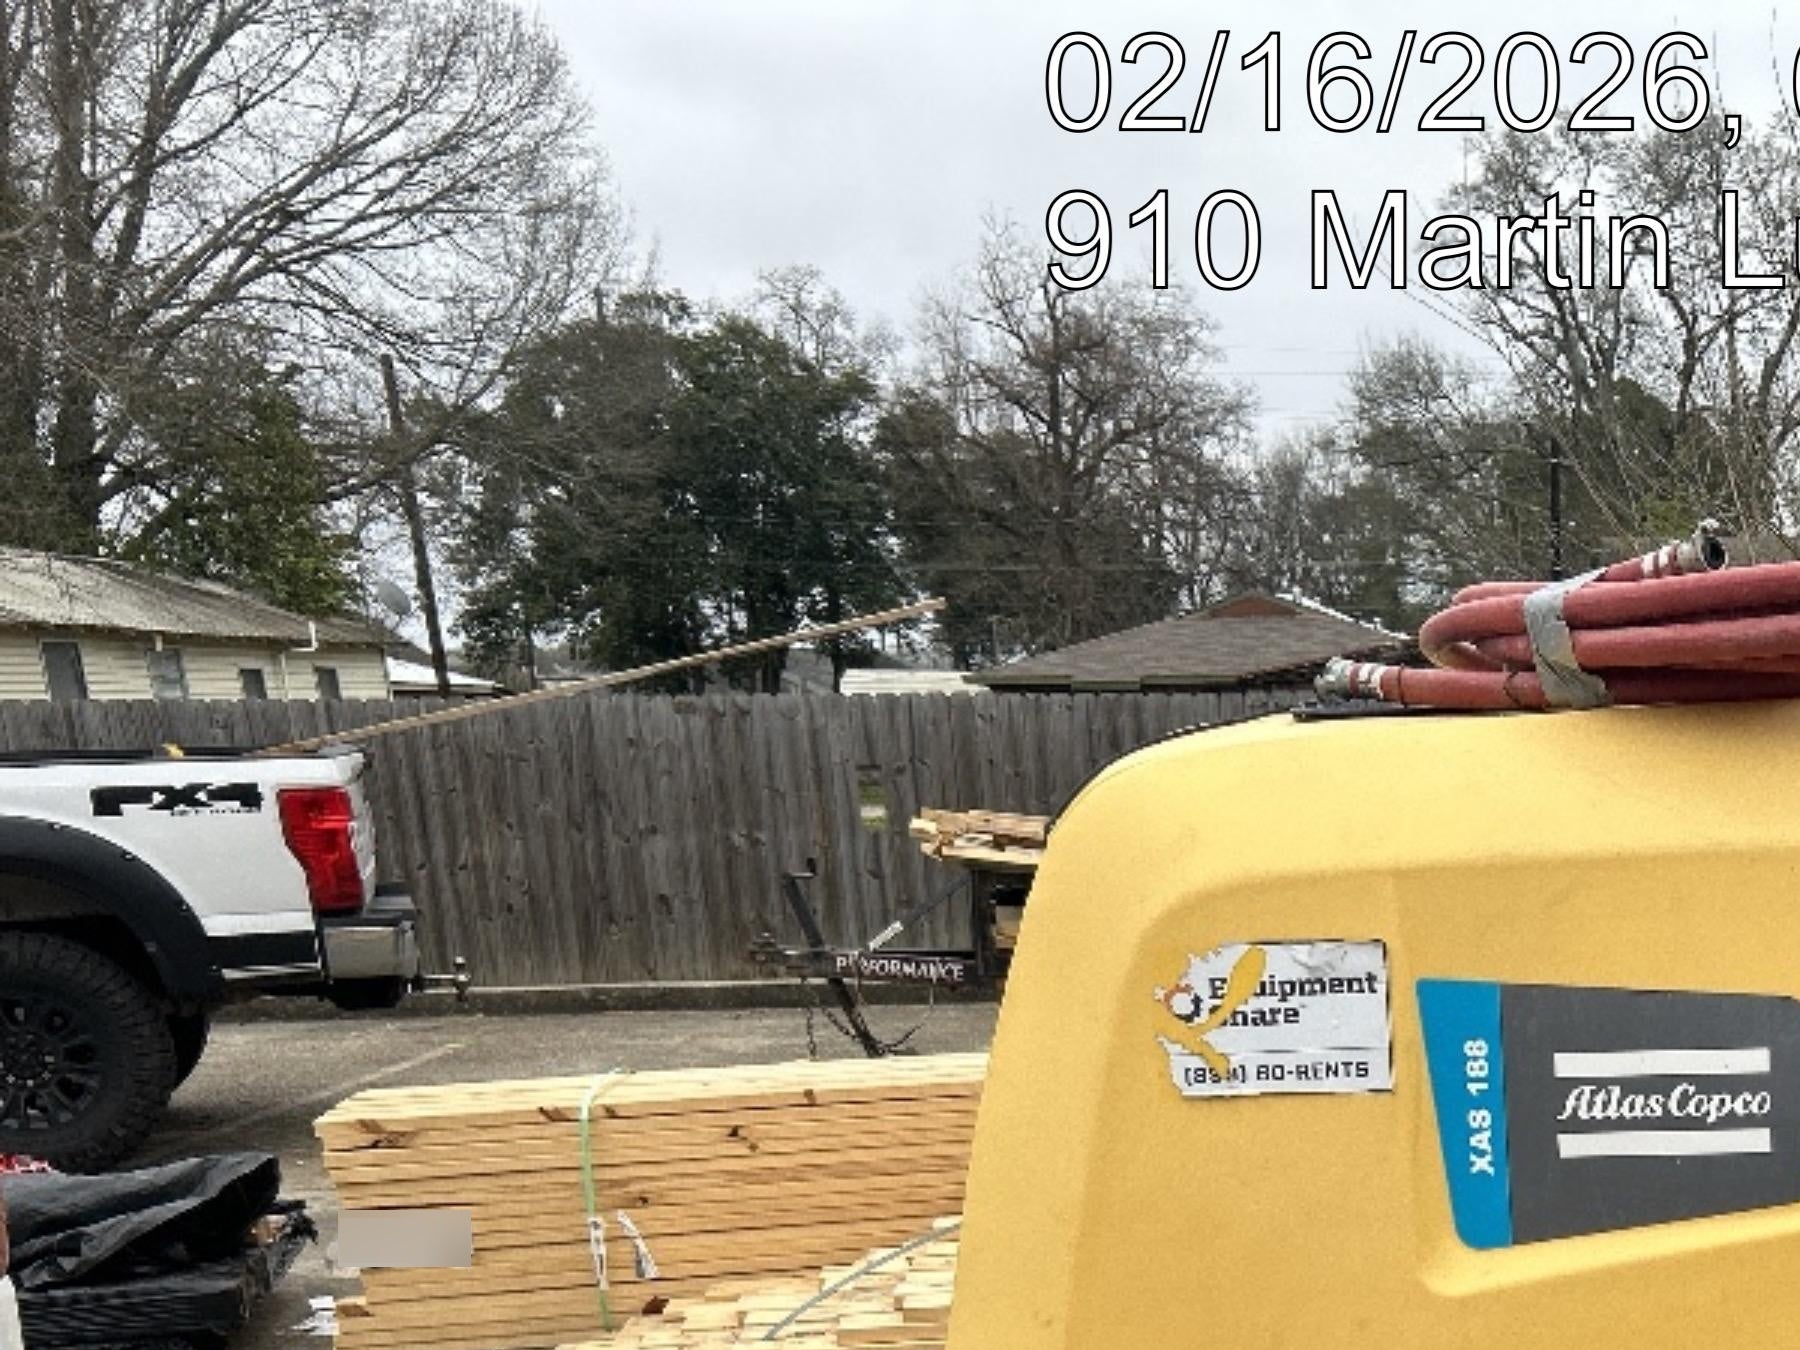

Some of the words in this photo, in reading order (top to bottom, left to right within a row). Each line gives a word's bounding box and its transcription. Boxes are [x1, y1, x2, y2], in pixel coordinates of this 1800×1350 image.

[1208, 972, 1378, 1002] Euipment
[1463, 1037, 1489, 1097] 188
[1556, 1085, 1665, 1120] Atlas
[1668, 1082, 1772, 1124] Copco
[1468, 1107, 1496, 1177] XAS
